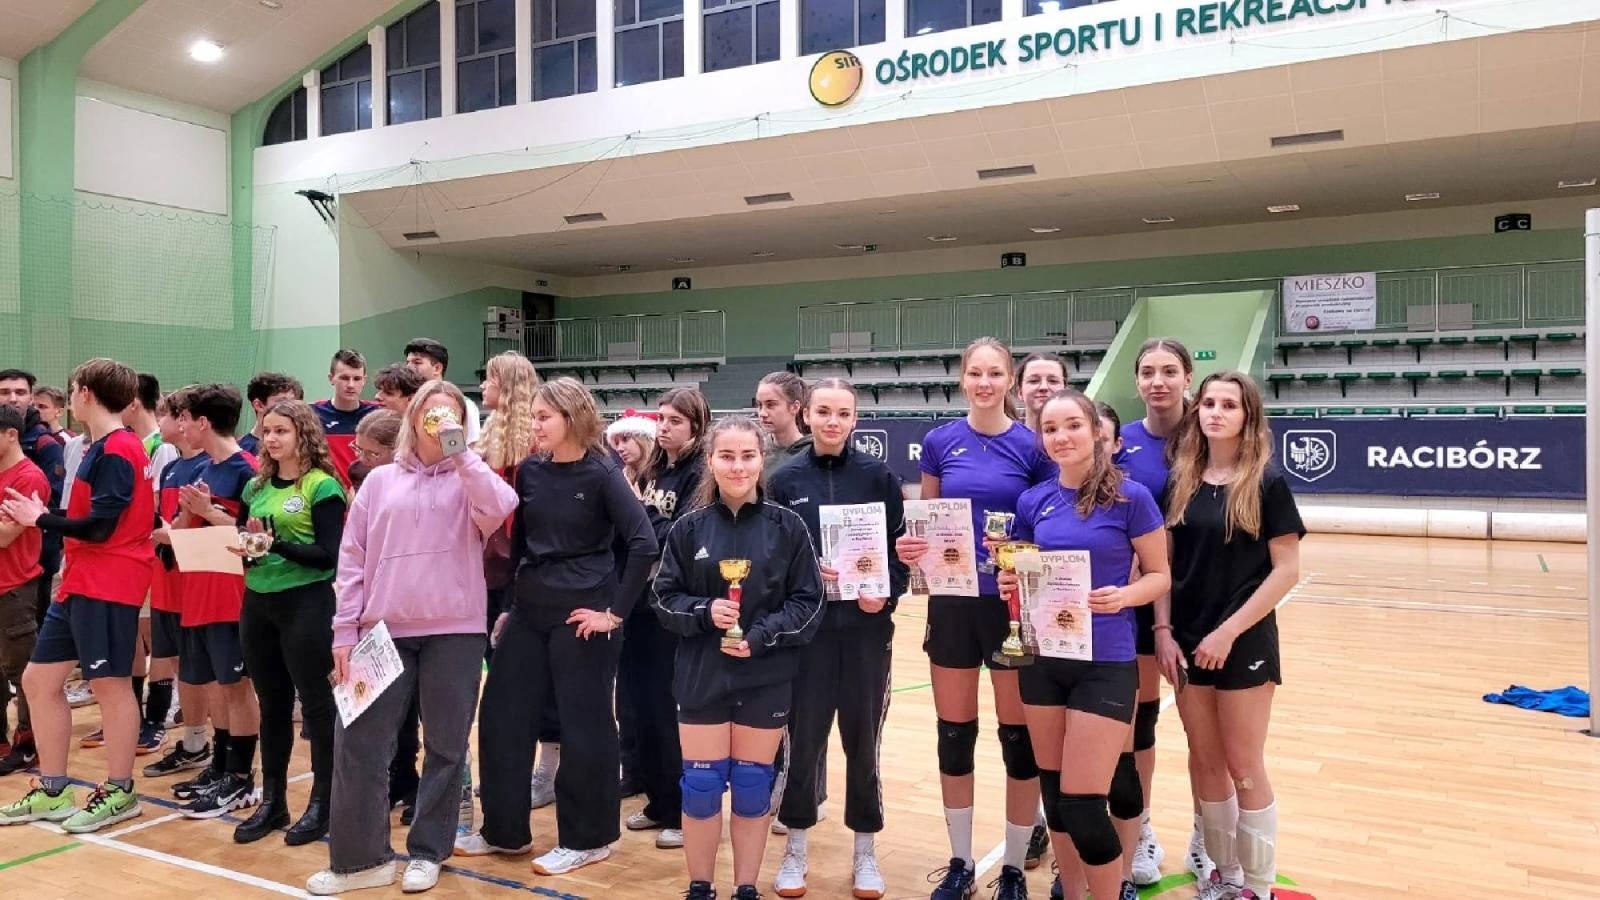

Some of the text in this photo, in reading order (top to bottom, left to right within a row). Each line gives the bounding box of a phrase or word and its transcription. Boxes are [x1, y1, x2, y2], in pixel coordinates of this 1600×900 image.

[875, 39, 1006, 85] OŚRODEK
[1018, 16, 1141, 62] SPORTU
[1155, 13, 1161, 41] I
[1518, 219, 1529, 229] C
[1012, 257, 1022, 265] B
[678, 281, 689, 289] A
[1294, 275, 1365, 291] MIESZKO
[1367, 439, 1542, 470] RACIBÓRZ
[1039, 554, 1087, 563] DYPLOM
